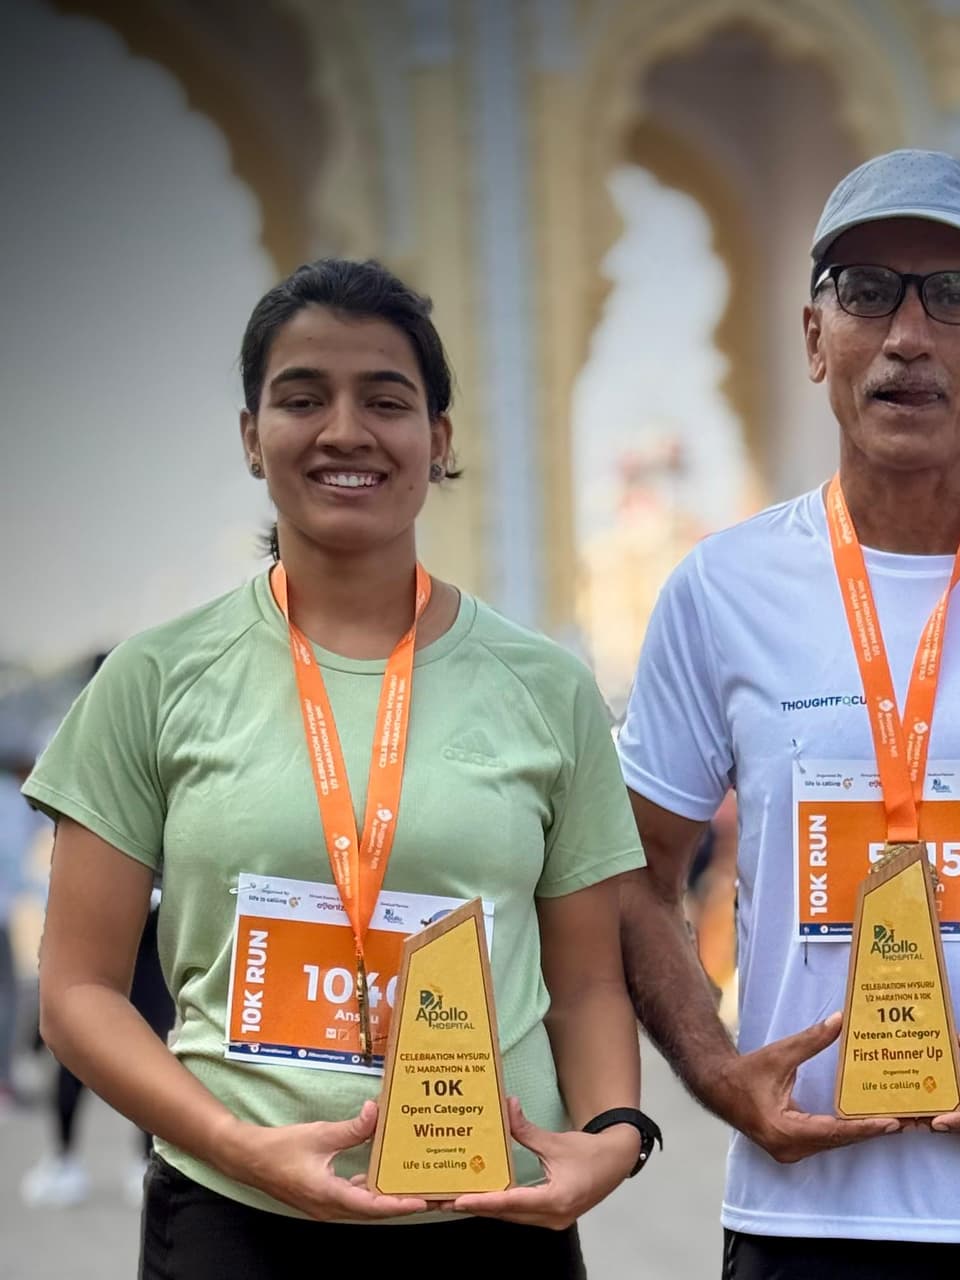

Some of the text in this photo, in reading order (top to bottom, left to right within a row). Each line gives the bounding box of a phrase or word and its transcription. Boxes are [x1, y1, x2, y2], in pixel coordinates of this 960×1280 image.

[781, 696, 867, 711] THOUGHTFOCU
[809, 815, 827, 916] 10K RUN
[871, 940, 917, 959] Apollo
[241, 930, 268, 1034] 10K RUN
[303, 964, 399, 1009] 104
[861, 981, 935, 991] CELEBRATION MYSURU
[876, 993, 912, 1001] MARATHON
[415, 1007, 468, 1027] Apollo
[877, 1006, 915, 1022] 10K
[853, 1030, 941, 1040] Veteran Category
[457, 1052, 490, 1060] MYSURU
[854, 1046, 943, 1061] First Runner Up
[405, 1066, 415, 1074] 1/2
[417, 1065, 462, 1073] MARATHON
[472, 1065, 485, 1073] 10K
[422, 1080, 464, 1096] 10K
[862, 1081, 920, 1090] life is calling
[401, 1104, 484, 1116] Open Category
[414, 1123, 473, 1137] Winner
[403, 1160, 467, 1170] life is calling
